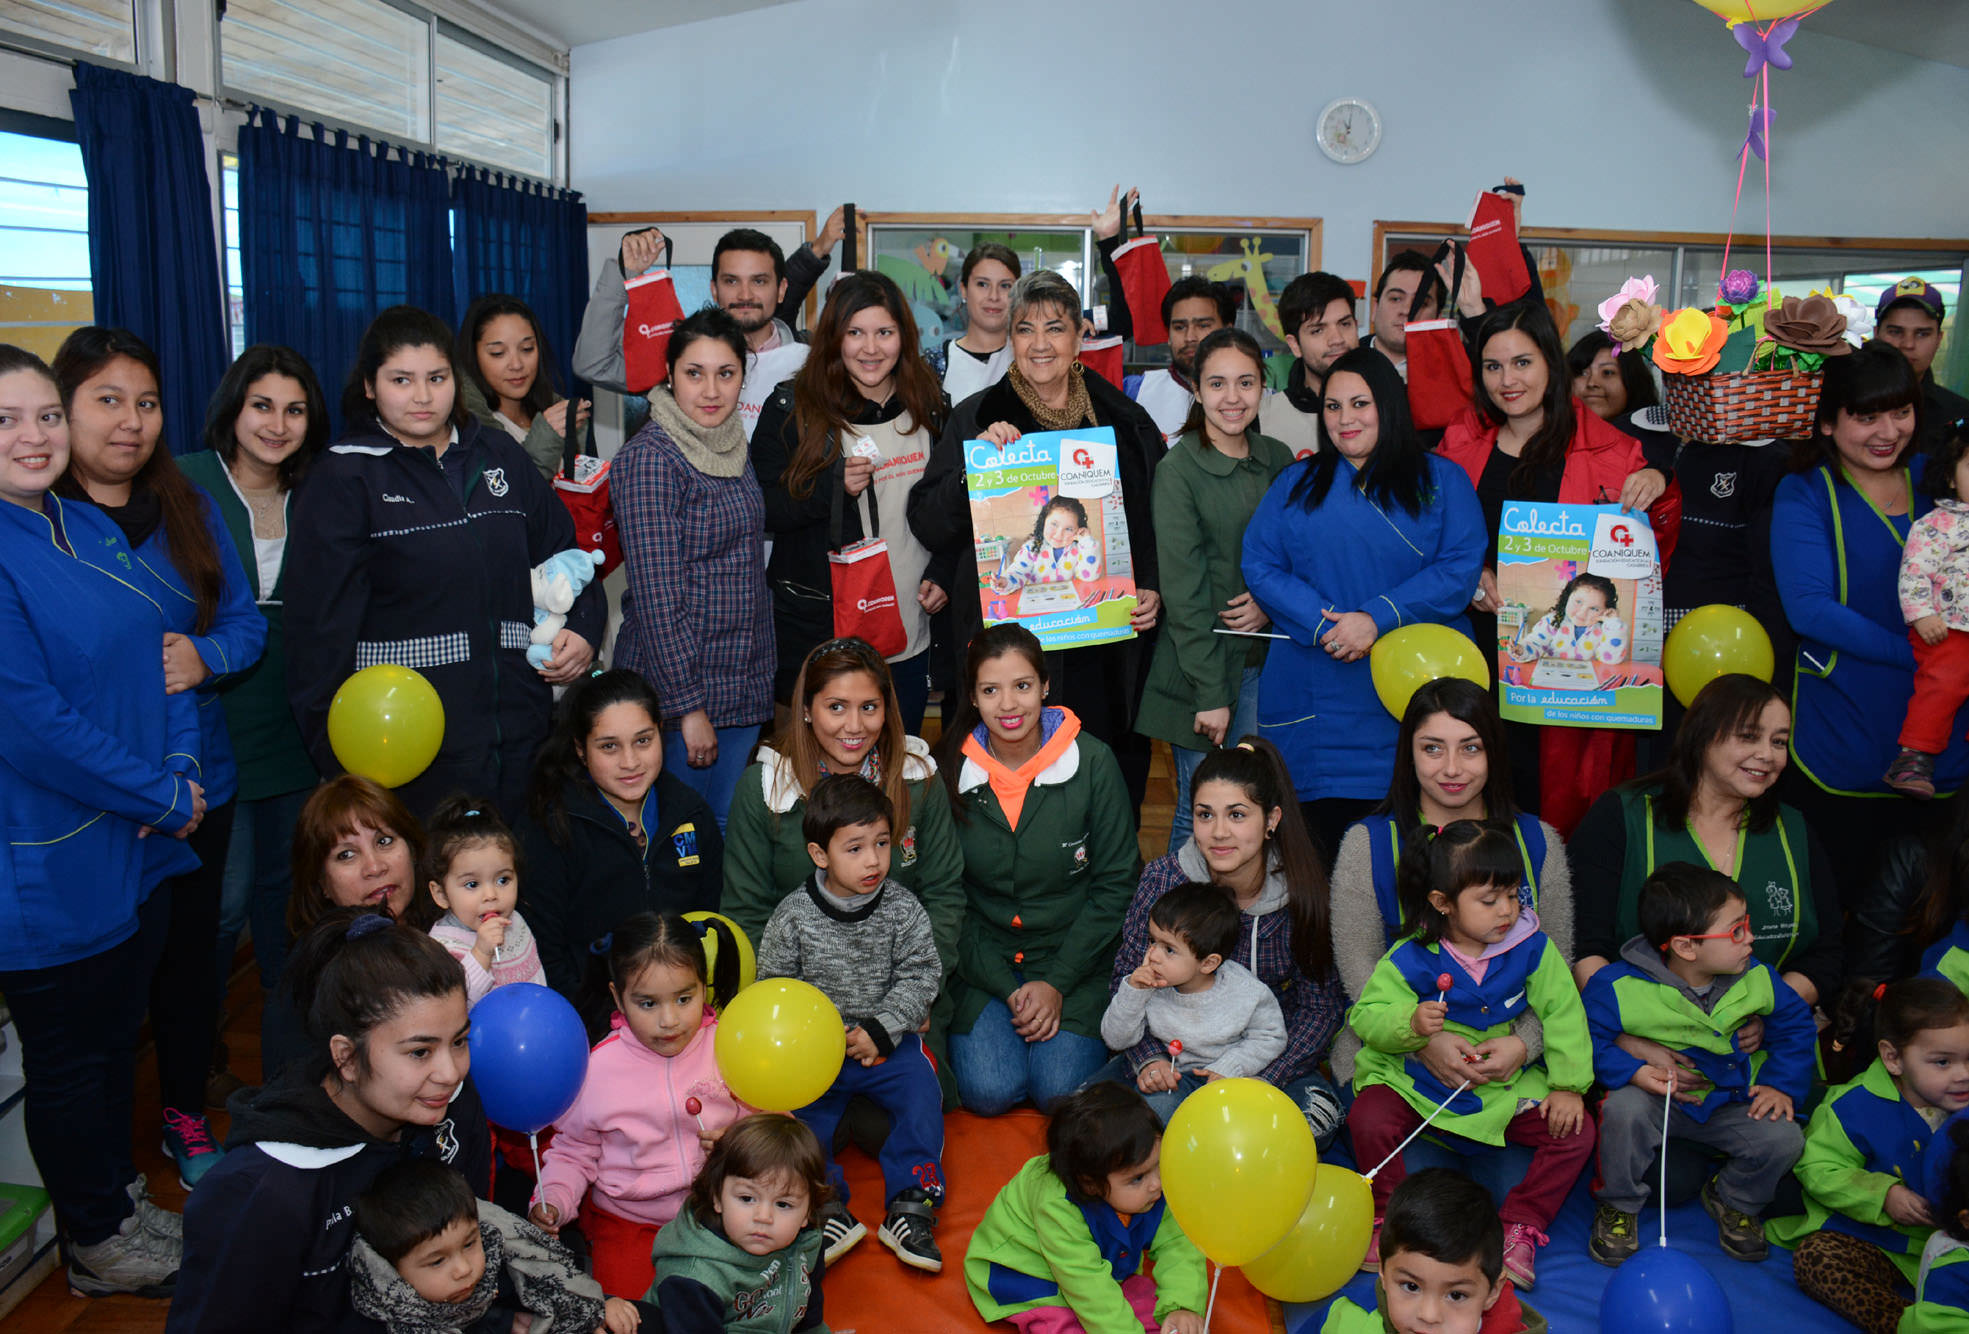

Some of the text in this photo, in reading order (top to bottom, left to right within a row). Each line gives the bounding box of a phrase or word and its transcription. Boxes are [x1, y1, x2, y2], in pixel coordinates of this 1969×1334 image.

[970, 440, 1053, 469] Colecta
[975, 470, 1057, 488] 2 y 3 de Octubre
[1060, 469, 1111, 481] COANIQUEM
[1503, 507, 1587, 537] Colecta
[1504, 535, 1588, 556] 2 y 3 de Octubre
[1592, 549, 1651, 558] COANIQUEM
[1029, 613, 1091, 631] educación
[1510, 691, 1609, 705] Por la educación
[1546, 709, 1655, 725] de los niños con quemaduras
